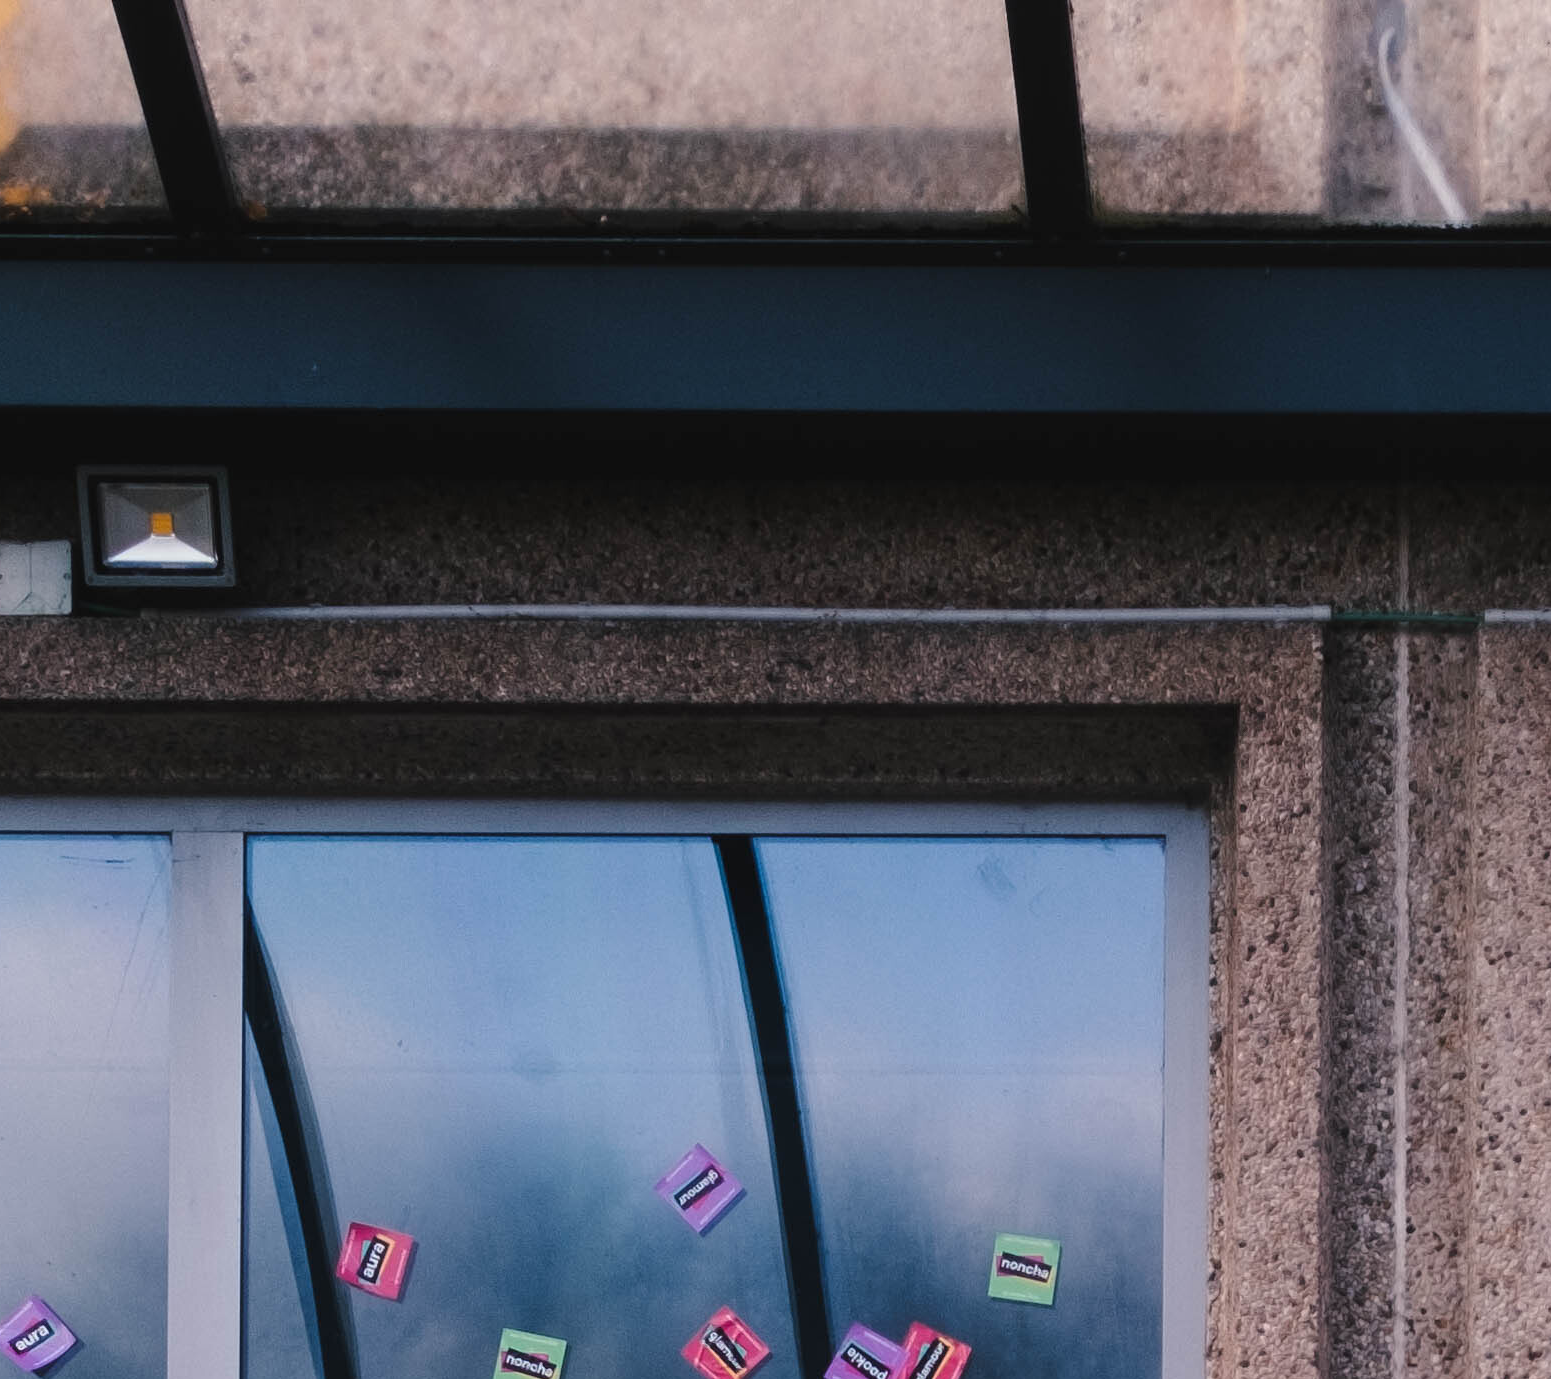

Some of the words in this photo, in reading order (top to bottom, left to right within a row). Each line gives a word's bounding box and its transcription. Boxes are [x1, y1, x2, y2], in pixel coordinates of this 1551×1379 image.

[679, 1169, 718, 1205] glamour
[359, 1243, 385, 1282] aura
[1001, 1259, 1048, 1279] noncha
[15, 1325, 49, 1351] aura
[702, 1326, 745, 1369] glamour
[506, 1355, 553, 1378] noncha
